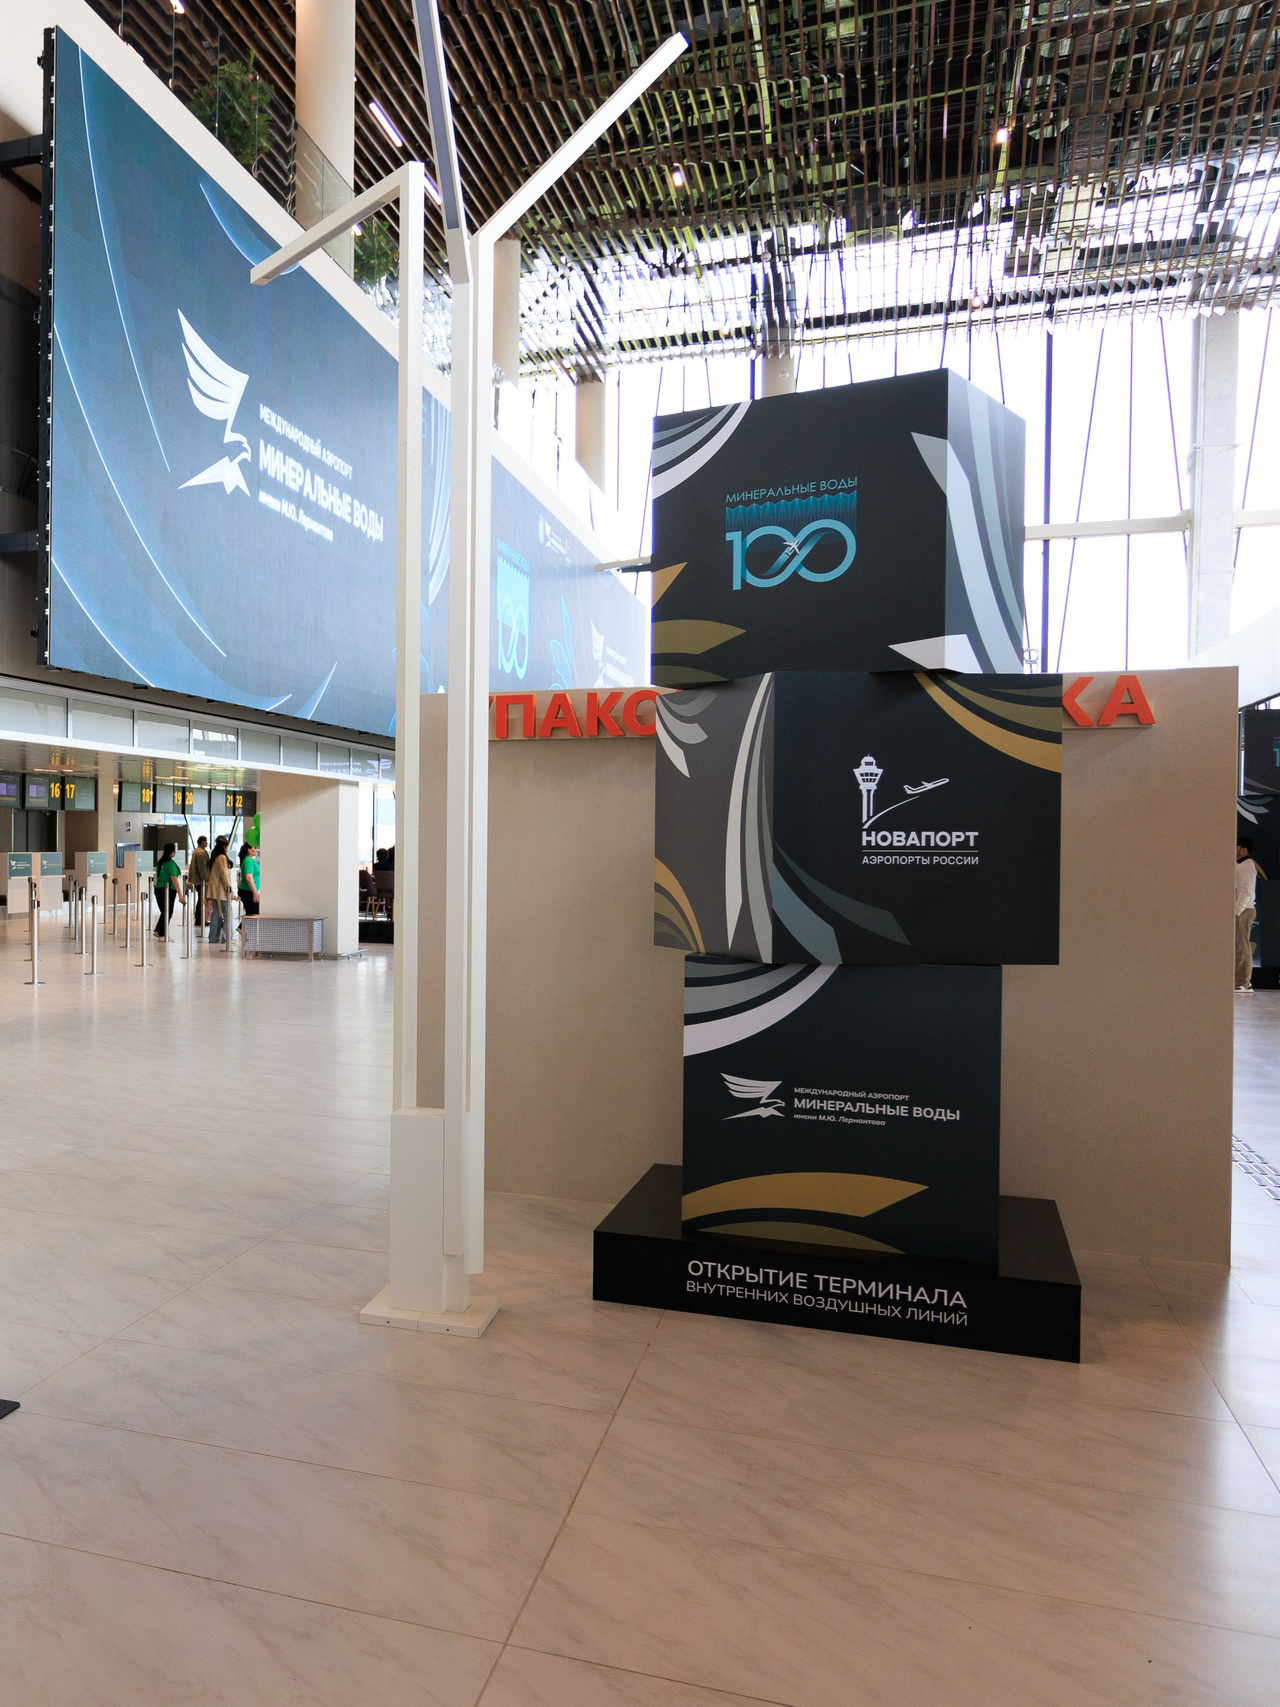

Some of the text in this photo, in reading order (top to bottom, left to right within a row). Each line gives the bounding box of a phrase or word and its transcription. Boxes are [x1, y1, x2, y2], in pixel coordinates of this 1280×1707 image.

[260, 402, 353, 480] МЕЖДУНАРОДНЫЙ АЭРОПОРТ
[259, 438, 384, 542] МИНЕРАЛЬНЫЕ ВОДЫ
[725, 476, 858, 503] МИНЕРАЛЬНЫЕ ВОДЫ
[725, 518, 857, 591] 100
[489, 690, 660, 738] ПАКО
[50, 782, 60, 798] 16
[65, 783, 76, 799] 17
[141, 788, 150, 802] 18
[174, 791, 182, 805] 19
[185, 791, 193, 805] 20
[226, 794, 234, 807] 21
[235, 795, 243, 808] 22
[862, 831, 979, 847] НОВАПОРТ
[862, 855, 979, 865] АЭРОПОРТЫ РОССИИ
[794, 1087, 909, 1101] МЕЖДУНАРОДНЫЙ АЭРОПОРТ
[793, 1097, 961, 1121] МИНЕРАЛЬНЫЕ ВОДЫ
[838, 1115, 886, 1126] Лермонтова
[687, 1260, 968, 1309] ОТКРЫТИЕ ТЕРМИНАЛА
[686, 1280, 968, 1327] ВНУТРЕННИХ ВОЗДУШНЫХ ЛИНИЙ
